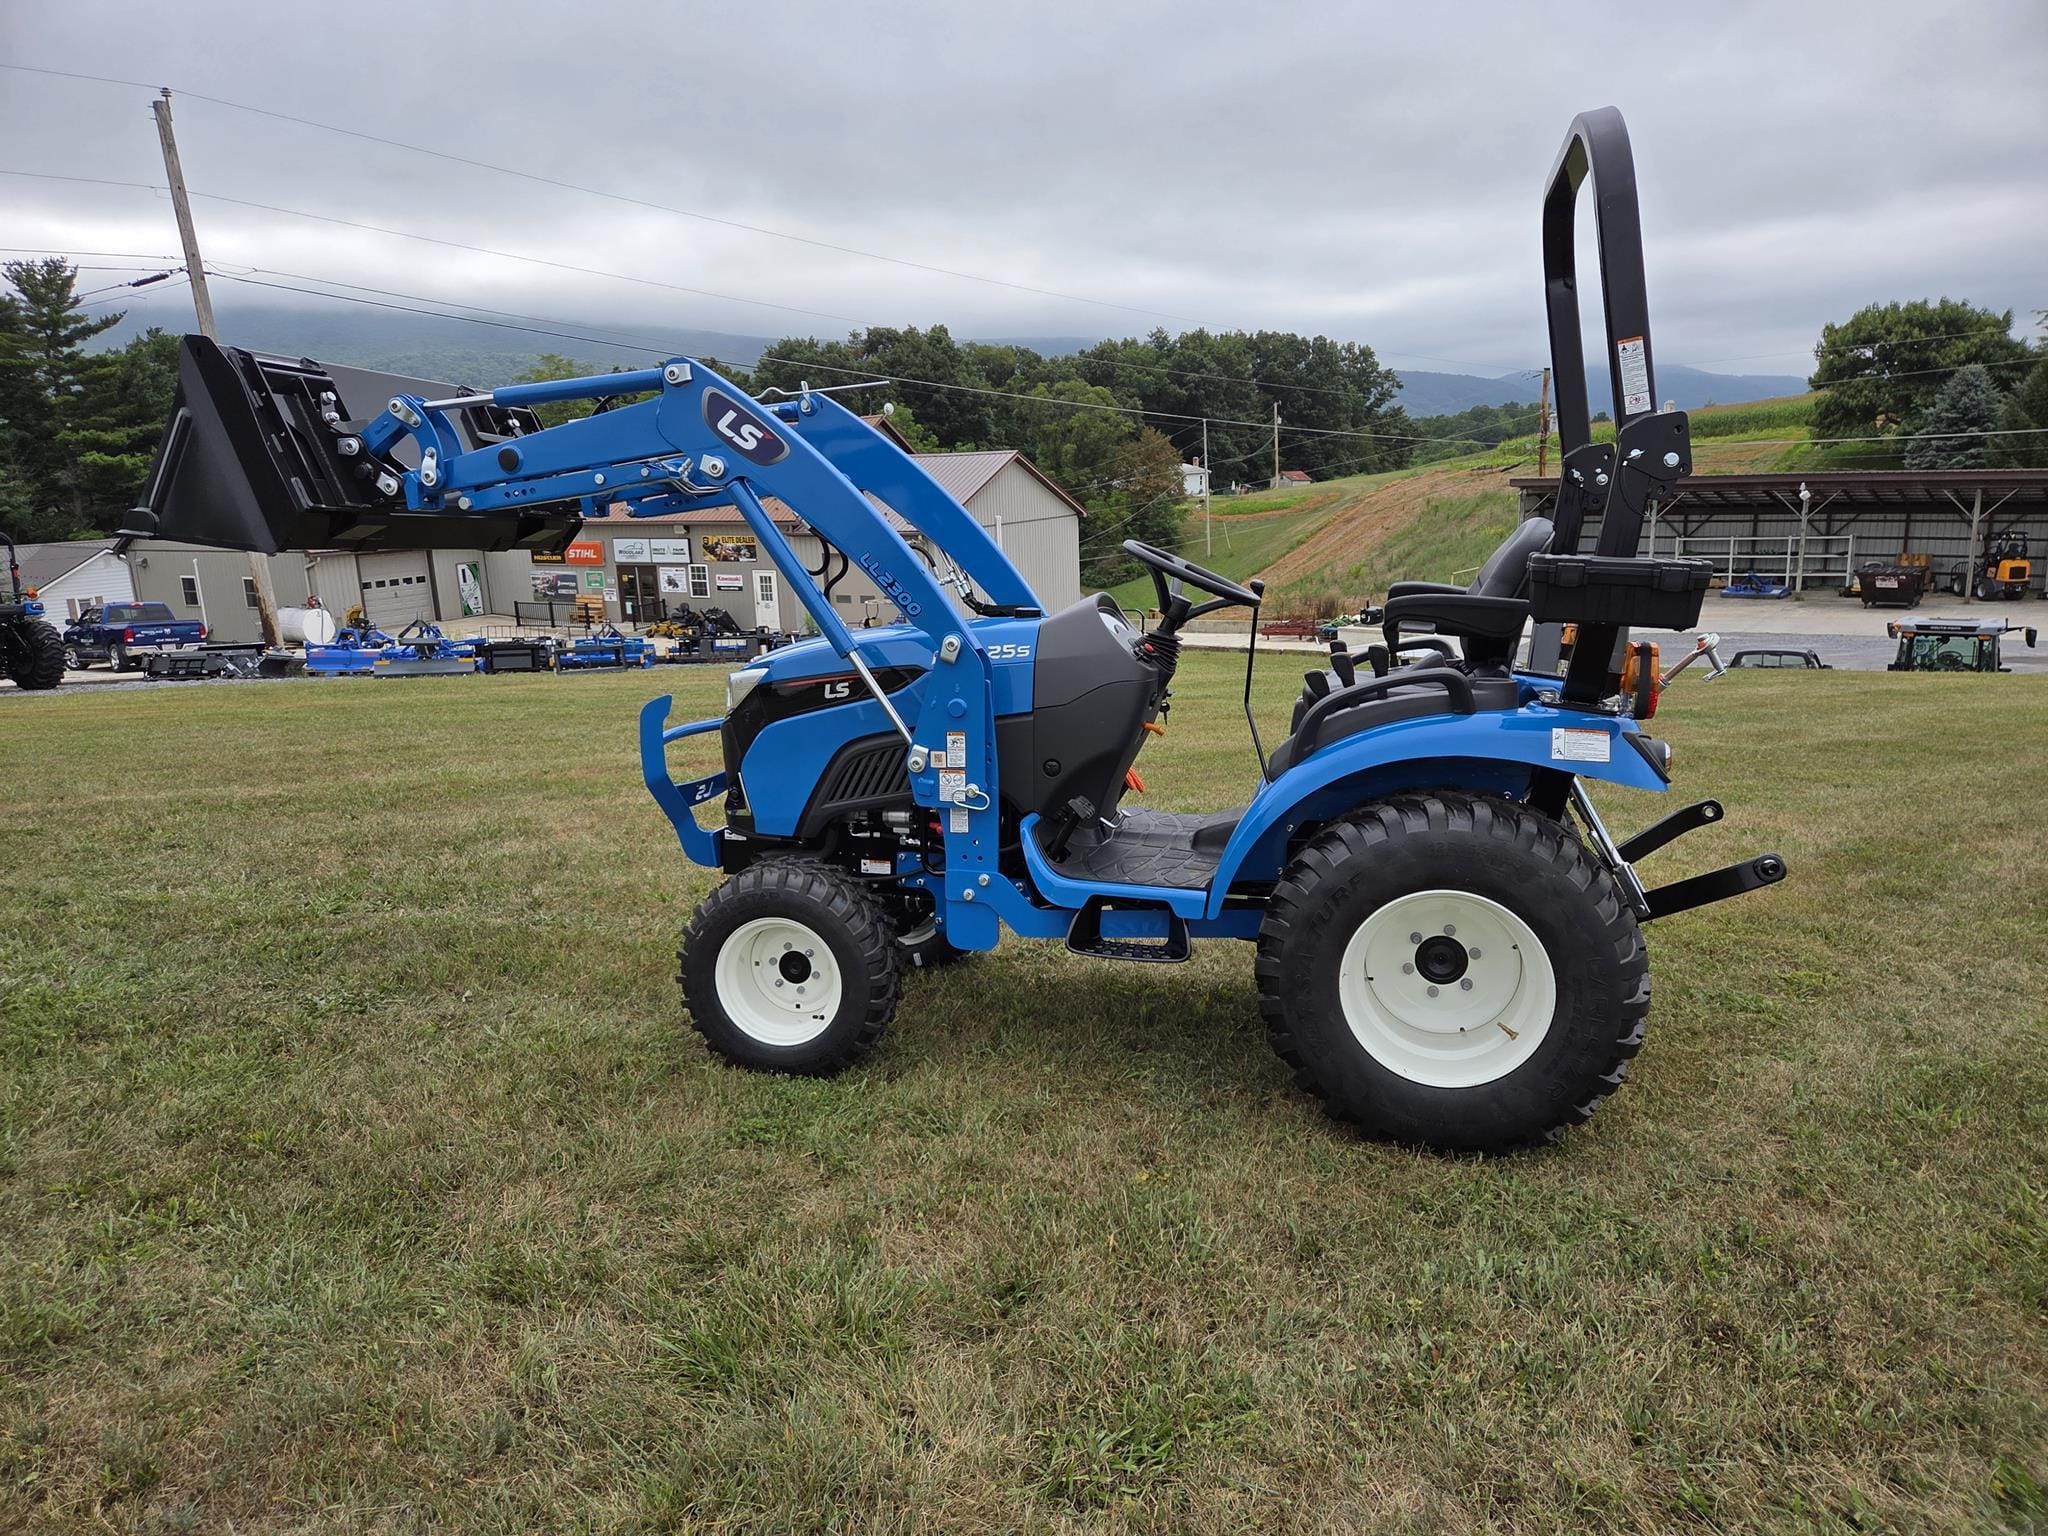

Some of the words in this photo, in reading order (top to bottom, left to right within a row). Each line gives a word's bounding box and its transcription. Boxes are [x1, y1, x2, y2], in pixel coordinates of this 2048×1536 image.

[716, 409, 764, 452] LS
[568, 549, 597, 558] STIHL
[859, 552, 923, 618] LL2300
[824, 681, 850, 699] LS
[1309, 870, 1363, 935] TURF
